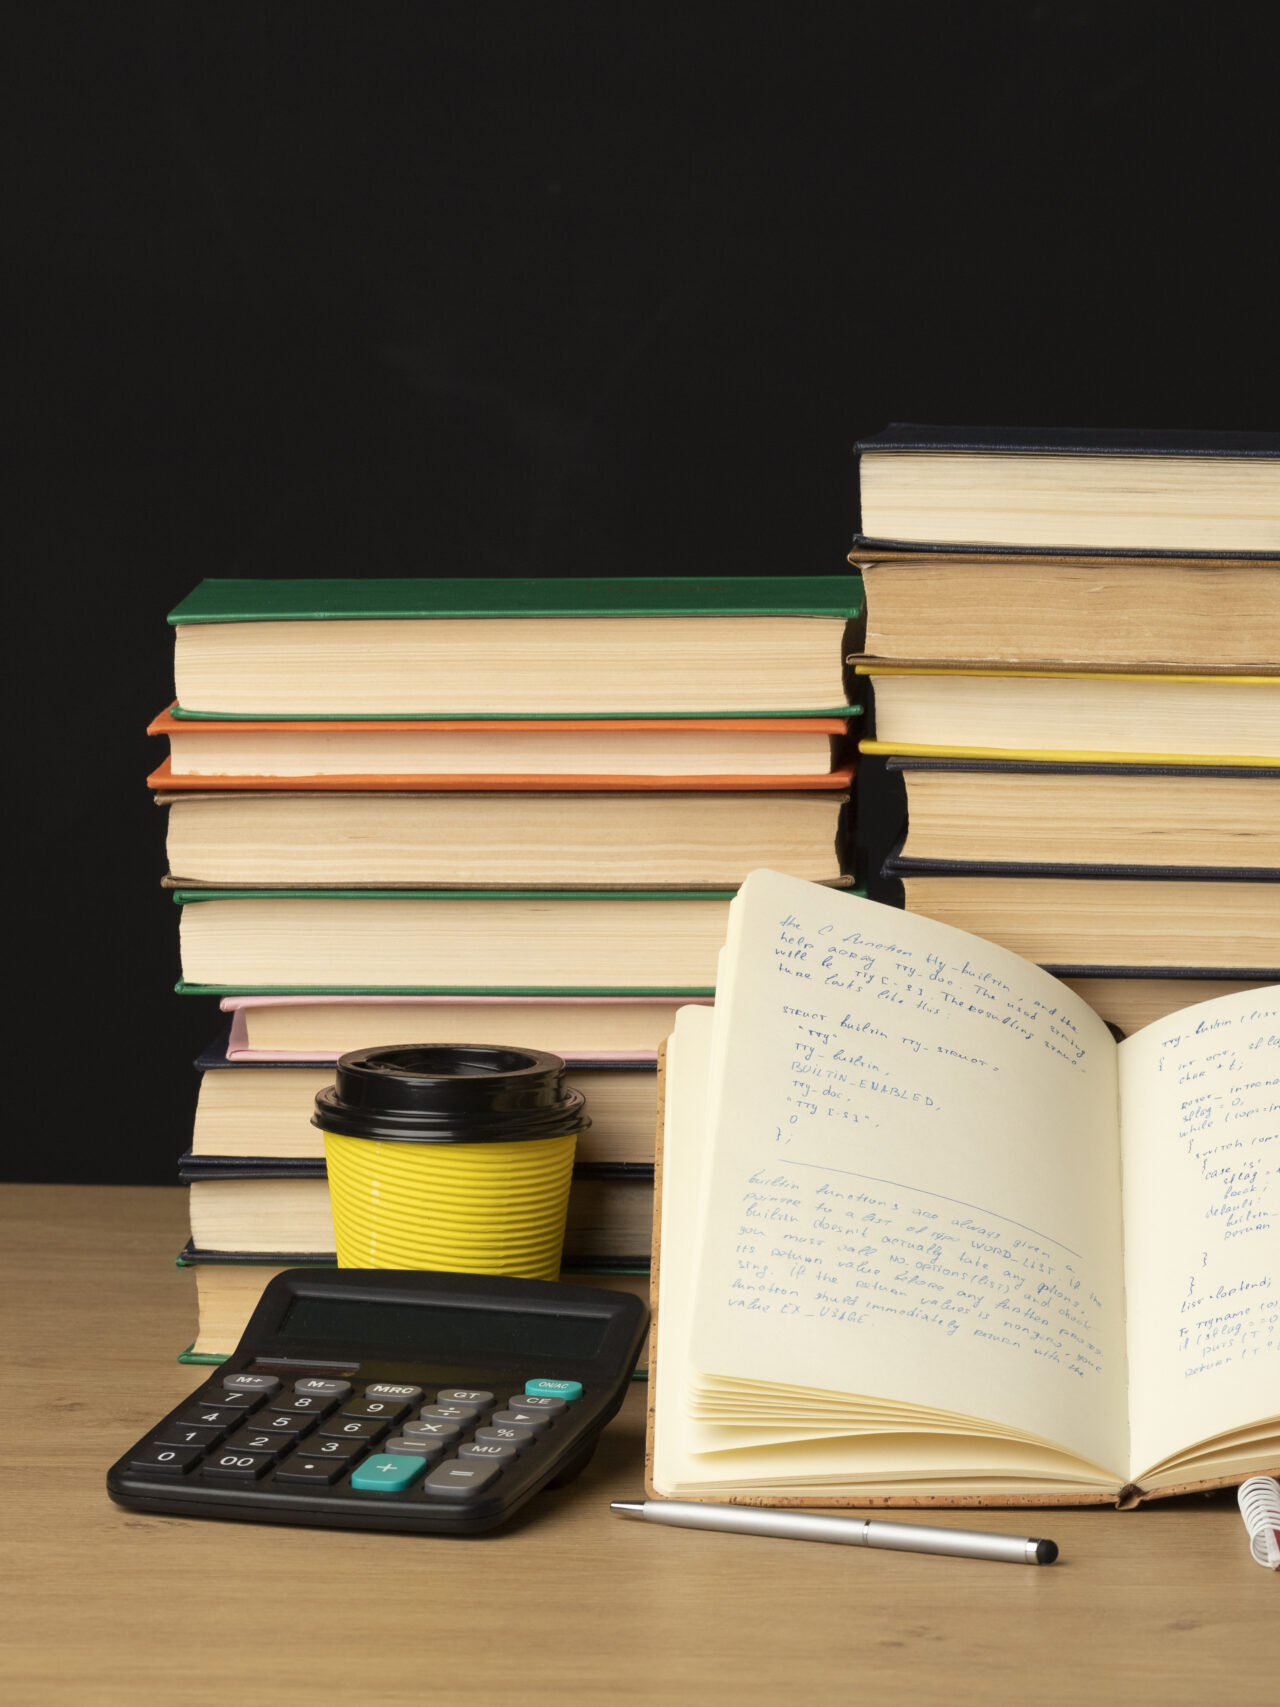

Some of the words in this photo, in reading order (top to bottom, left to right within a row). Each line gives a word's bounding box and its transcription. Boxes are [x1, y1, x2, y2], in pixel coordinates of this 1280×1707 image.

[372, 1385, 415, 1394] MRC
[453, 1391, 480, 1399] GT
[538, 1381, 570, 1389] ON/AC
[224, 1392, 244, 1402] 7
[294, 1397, 312, 1408] 8
[366, 1403, 384, 1413] 9
[526, 1397, 552, 1405] CE
[201, 1411, 220, 1422] 4
[272, 1417, 293, 1427] 5
[343, 1422, 362, 1433] 6
[184, 1431, 197, 1442] 1
[249, 1437, 269, 1447] 2
[321, 1442, 340, 1452] 3
[497, 1428, 514, 1438] %
[471, 1445, 502, 1454] MU
[157, 1451, 176, 1462] 0
[219, 1456, 254, 1467] 00
